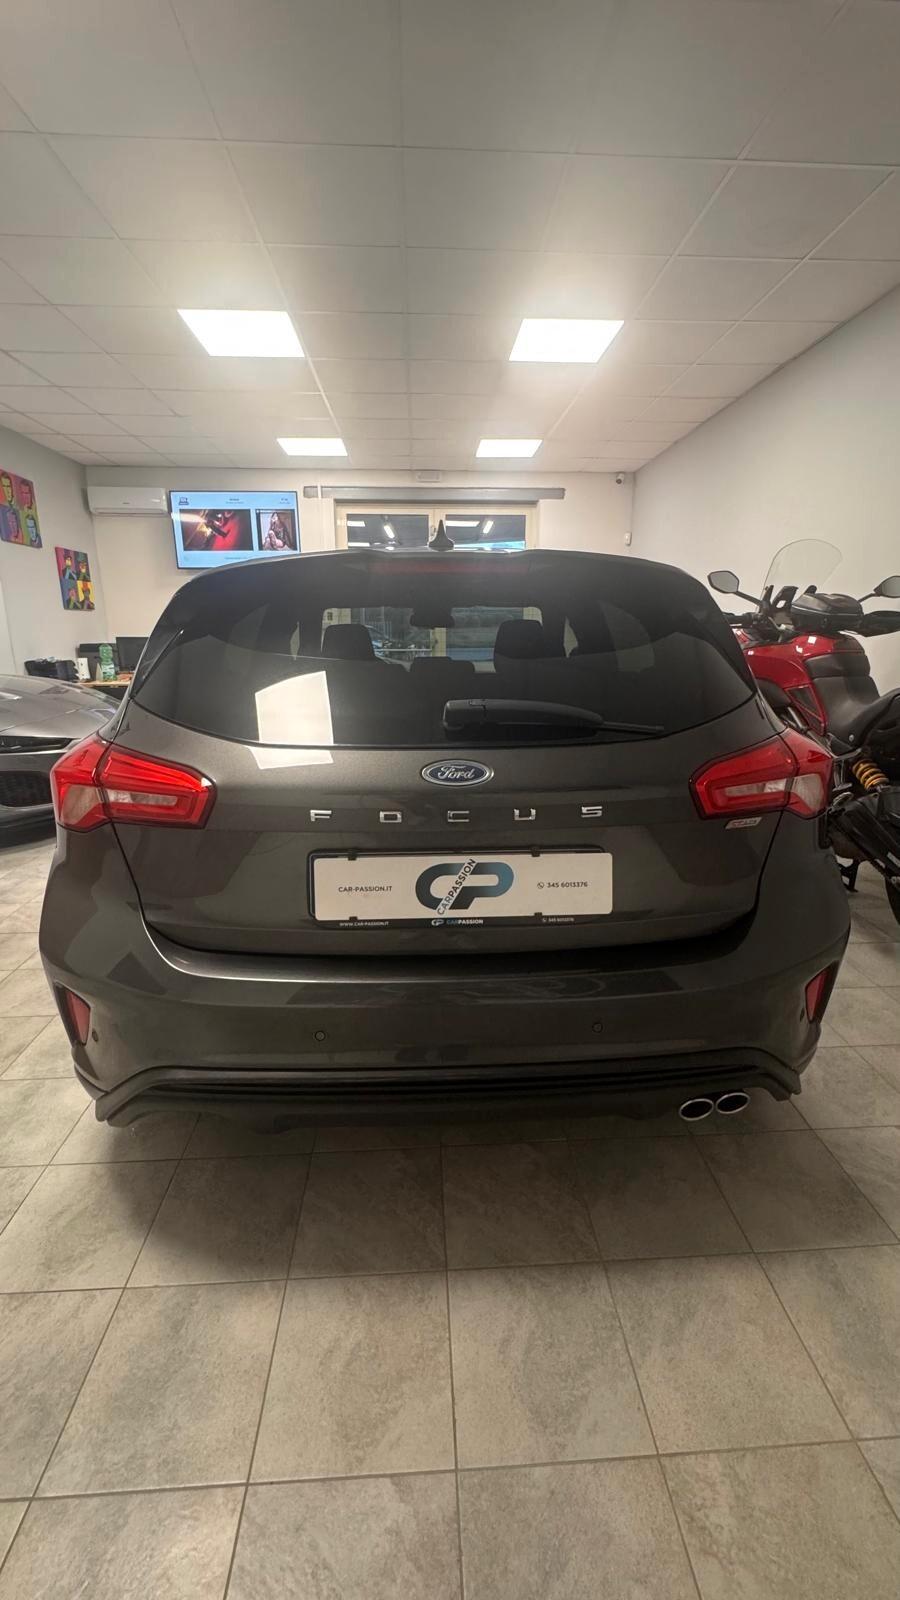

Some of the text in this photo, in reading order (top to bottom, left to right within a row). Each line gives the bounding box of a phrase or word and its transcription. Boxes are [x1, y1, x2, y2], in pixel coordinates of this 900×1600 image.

[437, 765, 476, 779] Ford
[310, 805, 603, 823] FOCUS
[437, 858, 477, 915] CARPASSION
